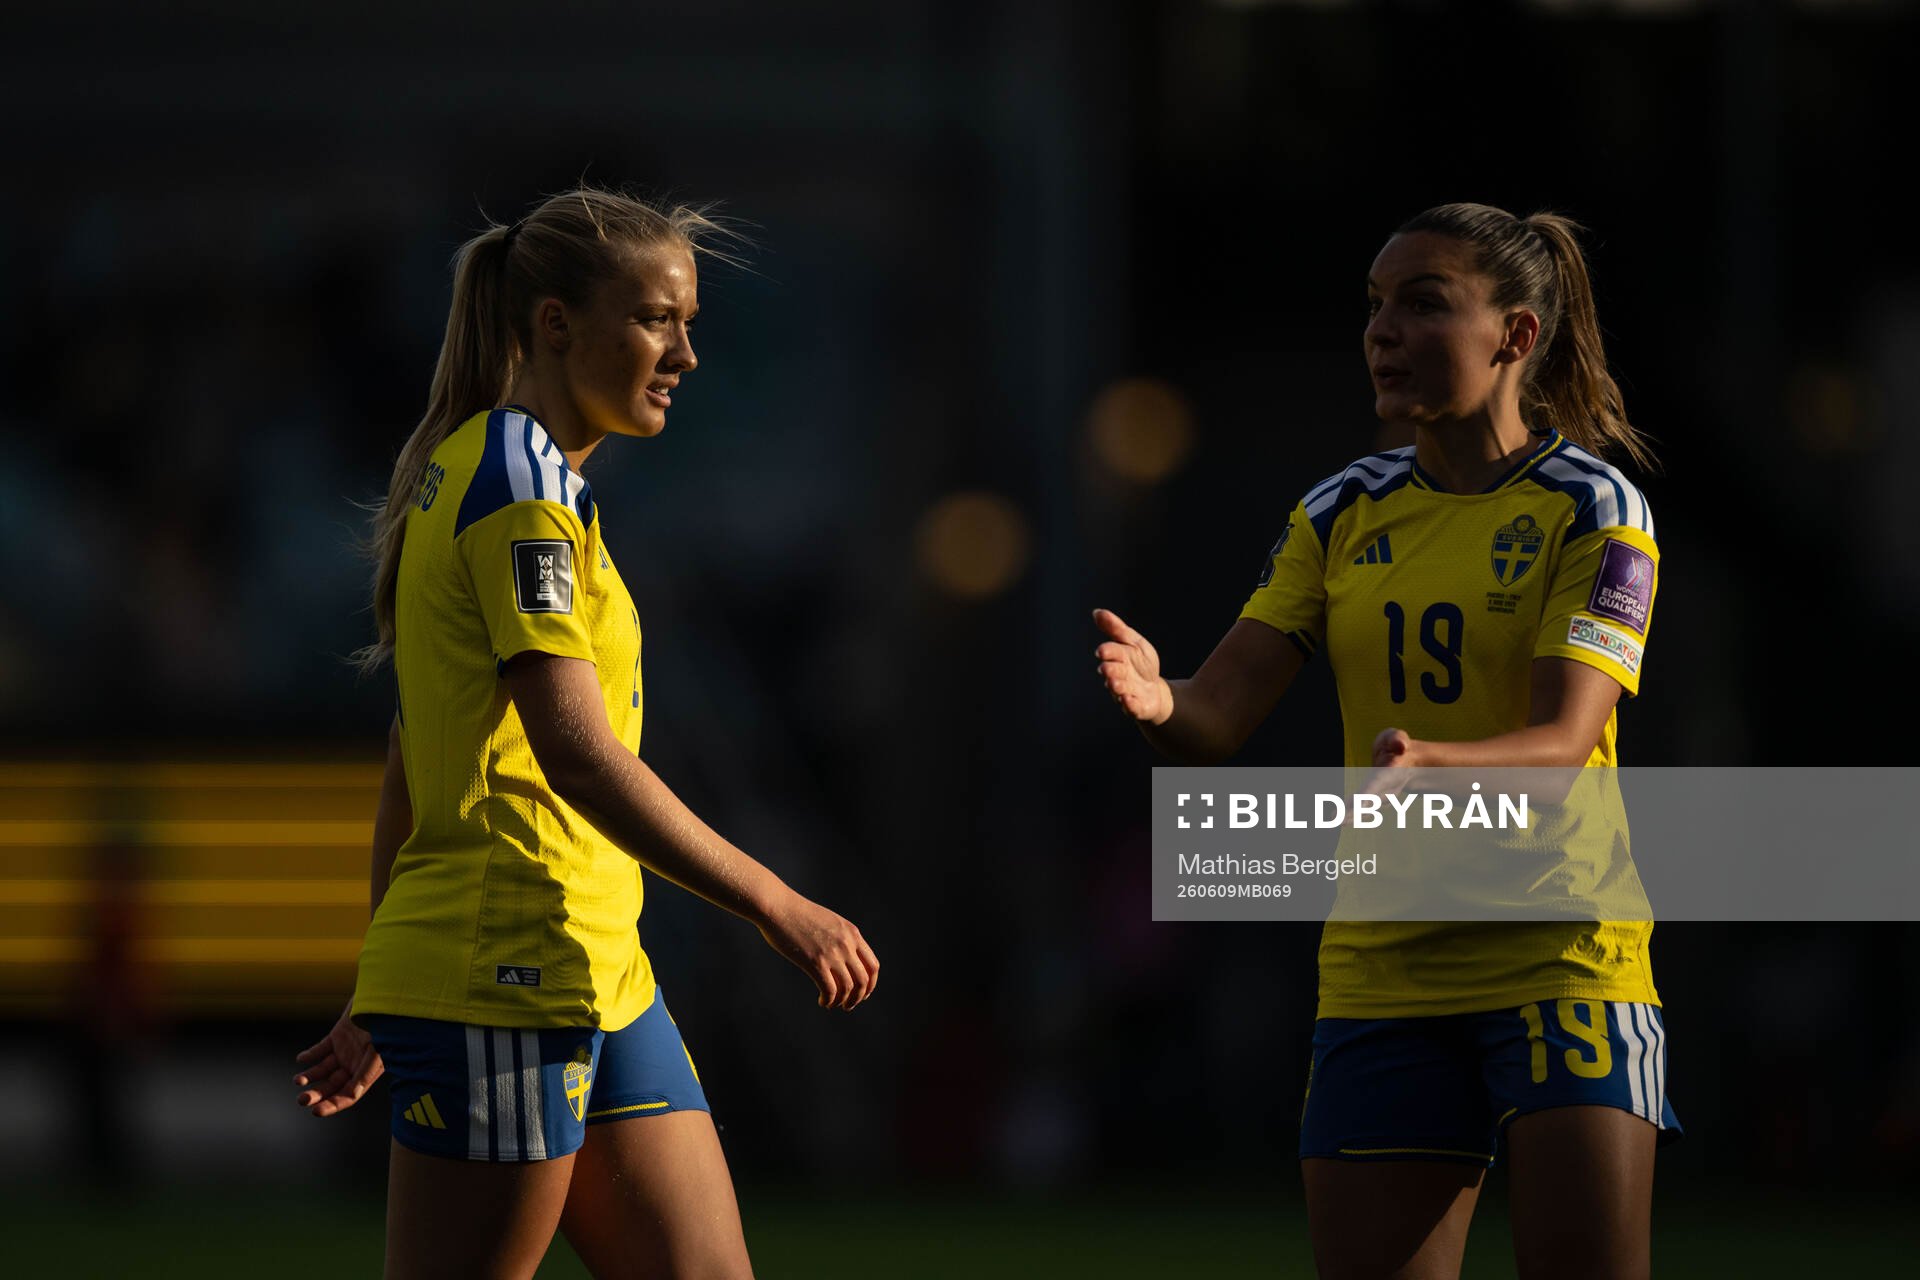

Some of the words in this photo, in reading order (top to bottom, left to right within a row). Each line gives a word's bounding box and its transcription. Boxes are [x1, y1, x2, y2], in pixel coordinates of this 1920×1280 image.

[1598, 596, 1645, 623] QUALIFIERS
[1601, 587, 1646, 614] EUROPEAN
[1384, 601, 1464, 704] 19
[1571, 626, 1641, 666] FOUNDATION
[1519, 998, 1614, 1085] 19
